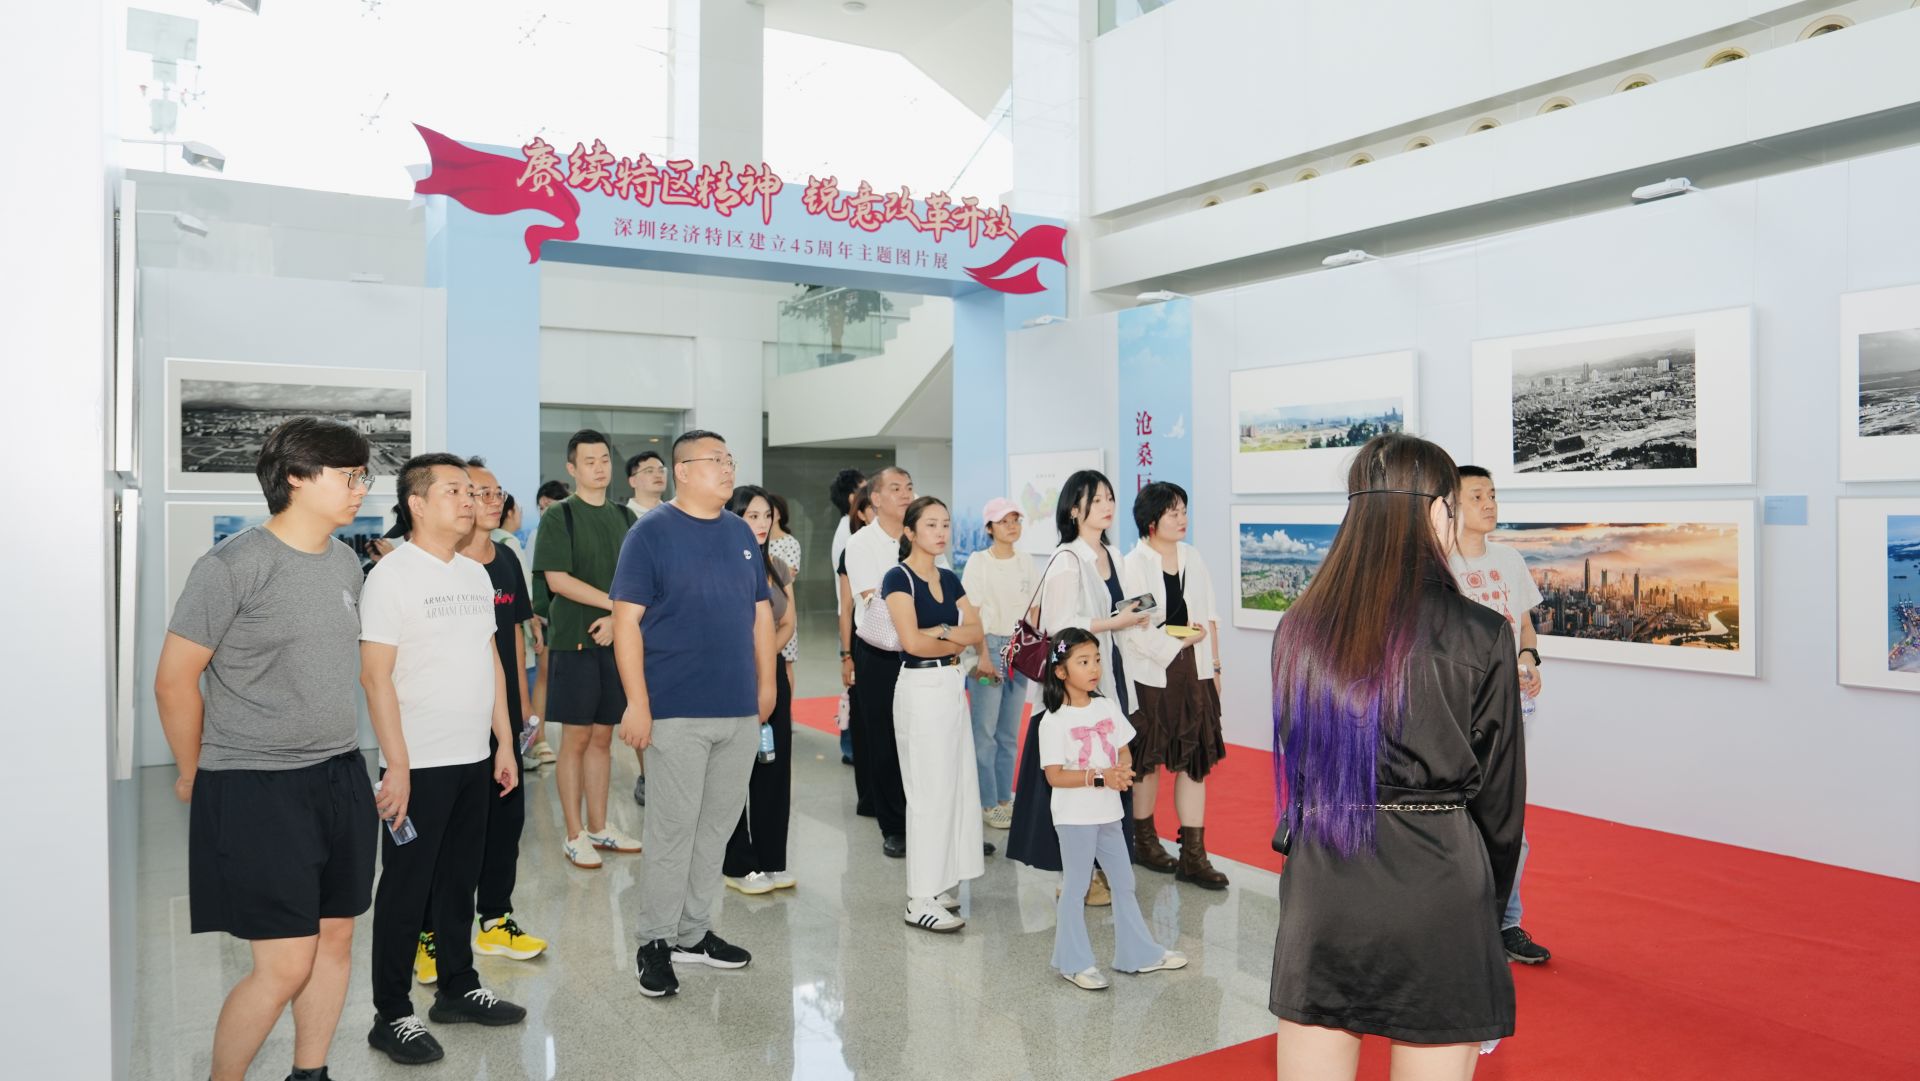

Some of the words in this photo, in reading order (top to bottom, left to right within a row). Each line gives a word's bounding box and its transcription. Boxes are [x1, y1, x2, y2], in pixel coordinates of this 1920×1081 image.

[517, 137, 783, 225] 赓续特区精神
[801, 175, 1019, 248] 锐意改革开放
[613, 217, 949, 270] 深圳经济特区建立45周年主题图片展
[424, 594, 454, 605] ARMANI
[425, 605, 457, 618] ARMANI
